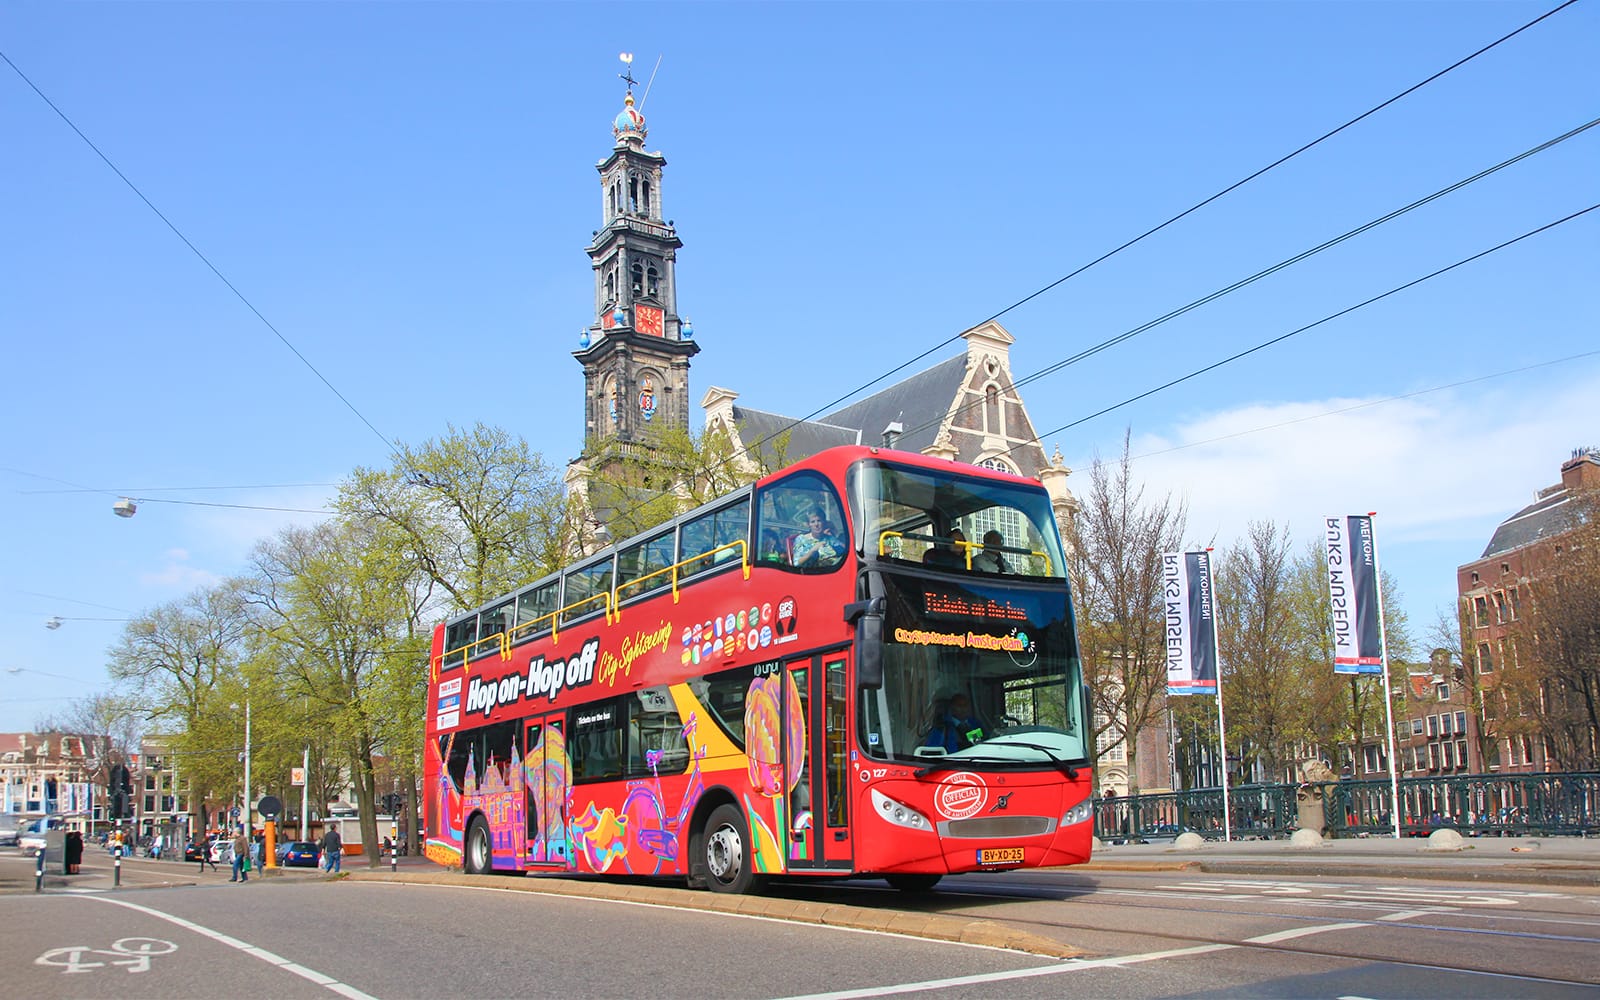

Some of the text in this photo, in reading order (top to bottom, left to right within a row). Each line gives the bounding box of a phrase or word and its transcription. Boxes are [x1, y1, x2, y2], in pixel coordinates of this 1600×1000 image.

[779, 600, 794, 612] GPS
[966, 631, 1023, 651] Amsterdam
[599, 619, 673, 687] City Sightseeing
[466, 677, 498, 715] Hop
[566, 640, 599, 686] off
[945, 787, 978, 803] OFFICIAL
